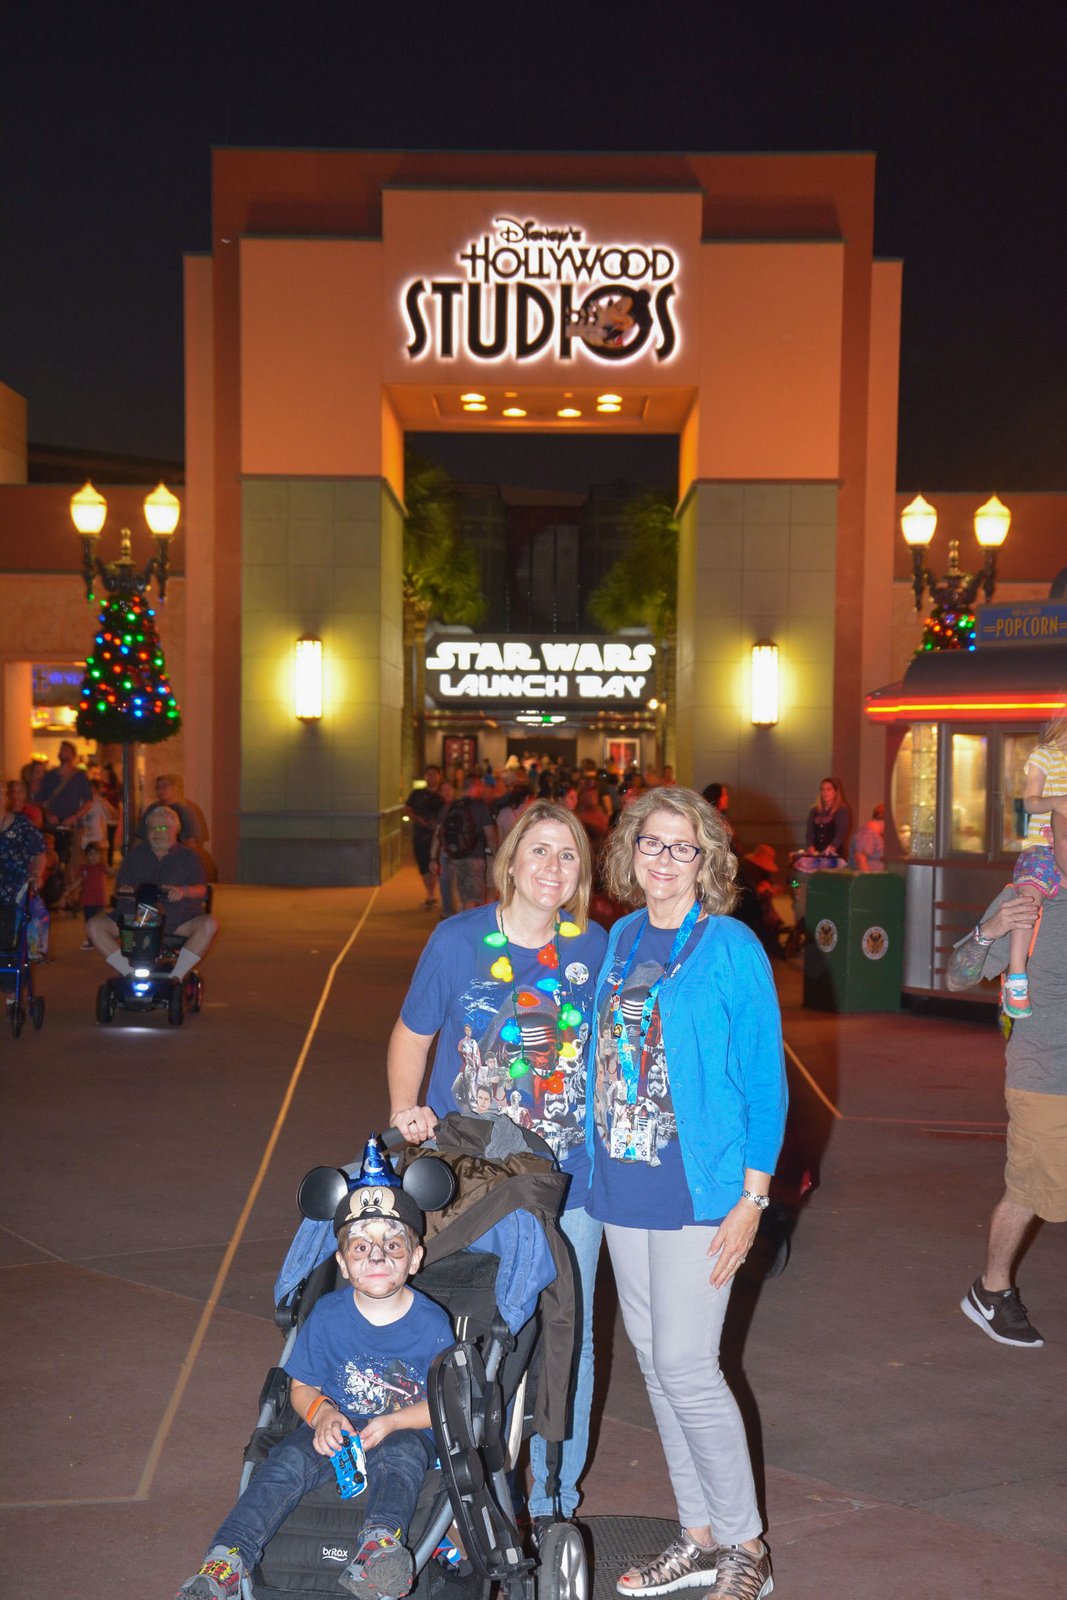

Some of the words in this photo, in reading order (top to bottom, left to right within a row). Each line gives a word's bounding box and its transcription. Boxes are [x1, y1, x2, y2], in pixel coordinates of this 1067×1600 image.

[495, 217, 582, 250] Disney's
[460, 236, 675, 284] HOLLYWOOD
[405, 279, 677, 361] STUDIOS
[995, 615, 1059, 638] POPCORN
[426, 642, 540, 671] STAR
[541, 643, 656, 672] WARS
[439, 674, 568, 697] LAUNCH
[576, 675, 646, 698] BAY
[322, 1546, 348, 1557] britax
